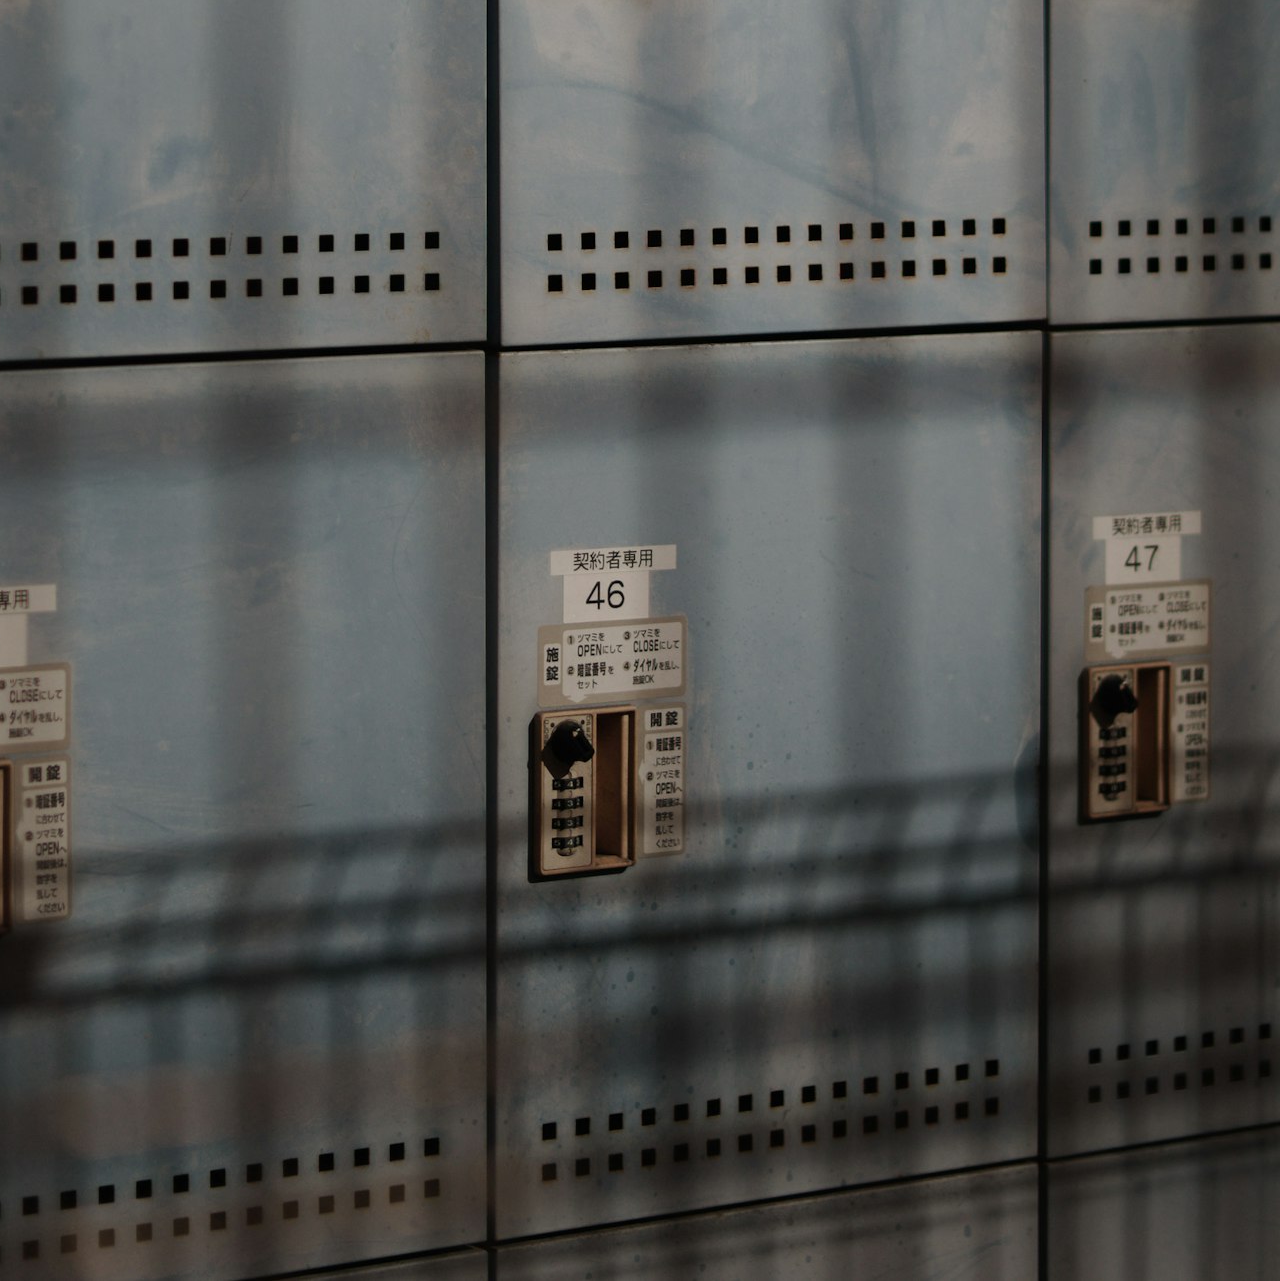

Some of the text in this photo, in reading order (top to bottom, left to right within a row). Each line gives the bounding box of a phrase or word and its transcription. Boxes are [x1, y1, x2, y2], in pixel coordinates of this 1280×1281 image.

[1113, 515, 1181, 535] 契約者専用
[573, 549, 653, 571] 契約者専用
[1125, 545, 1158, 572] 47
[586, 580, 625, 610] 46
[577, 633, 604, 644] ツマミを
[633, 628, 660, 639] ツマミを
[577, 642, 622, 656] OPENにして
[633, 637, 679, 653] CLOSEにして
[546, 647, 559, 681] 施錠
[577, 661, 614, 678] 暗証番号を
[577, 679, 597, 690] セット
[651, 711, 678, 727] 開錠
[656, 736, 681, 752] 暗証番号
[656, 769, 679, 780] ツマミを
[656, 781, 682, 795] OPENへ
[656, 838, 680, 848] ください
